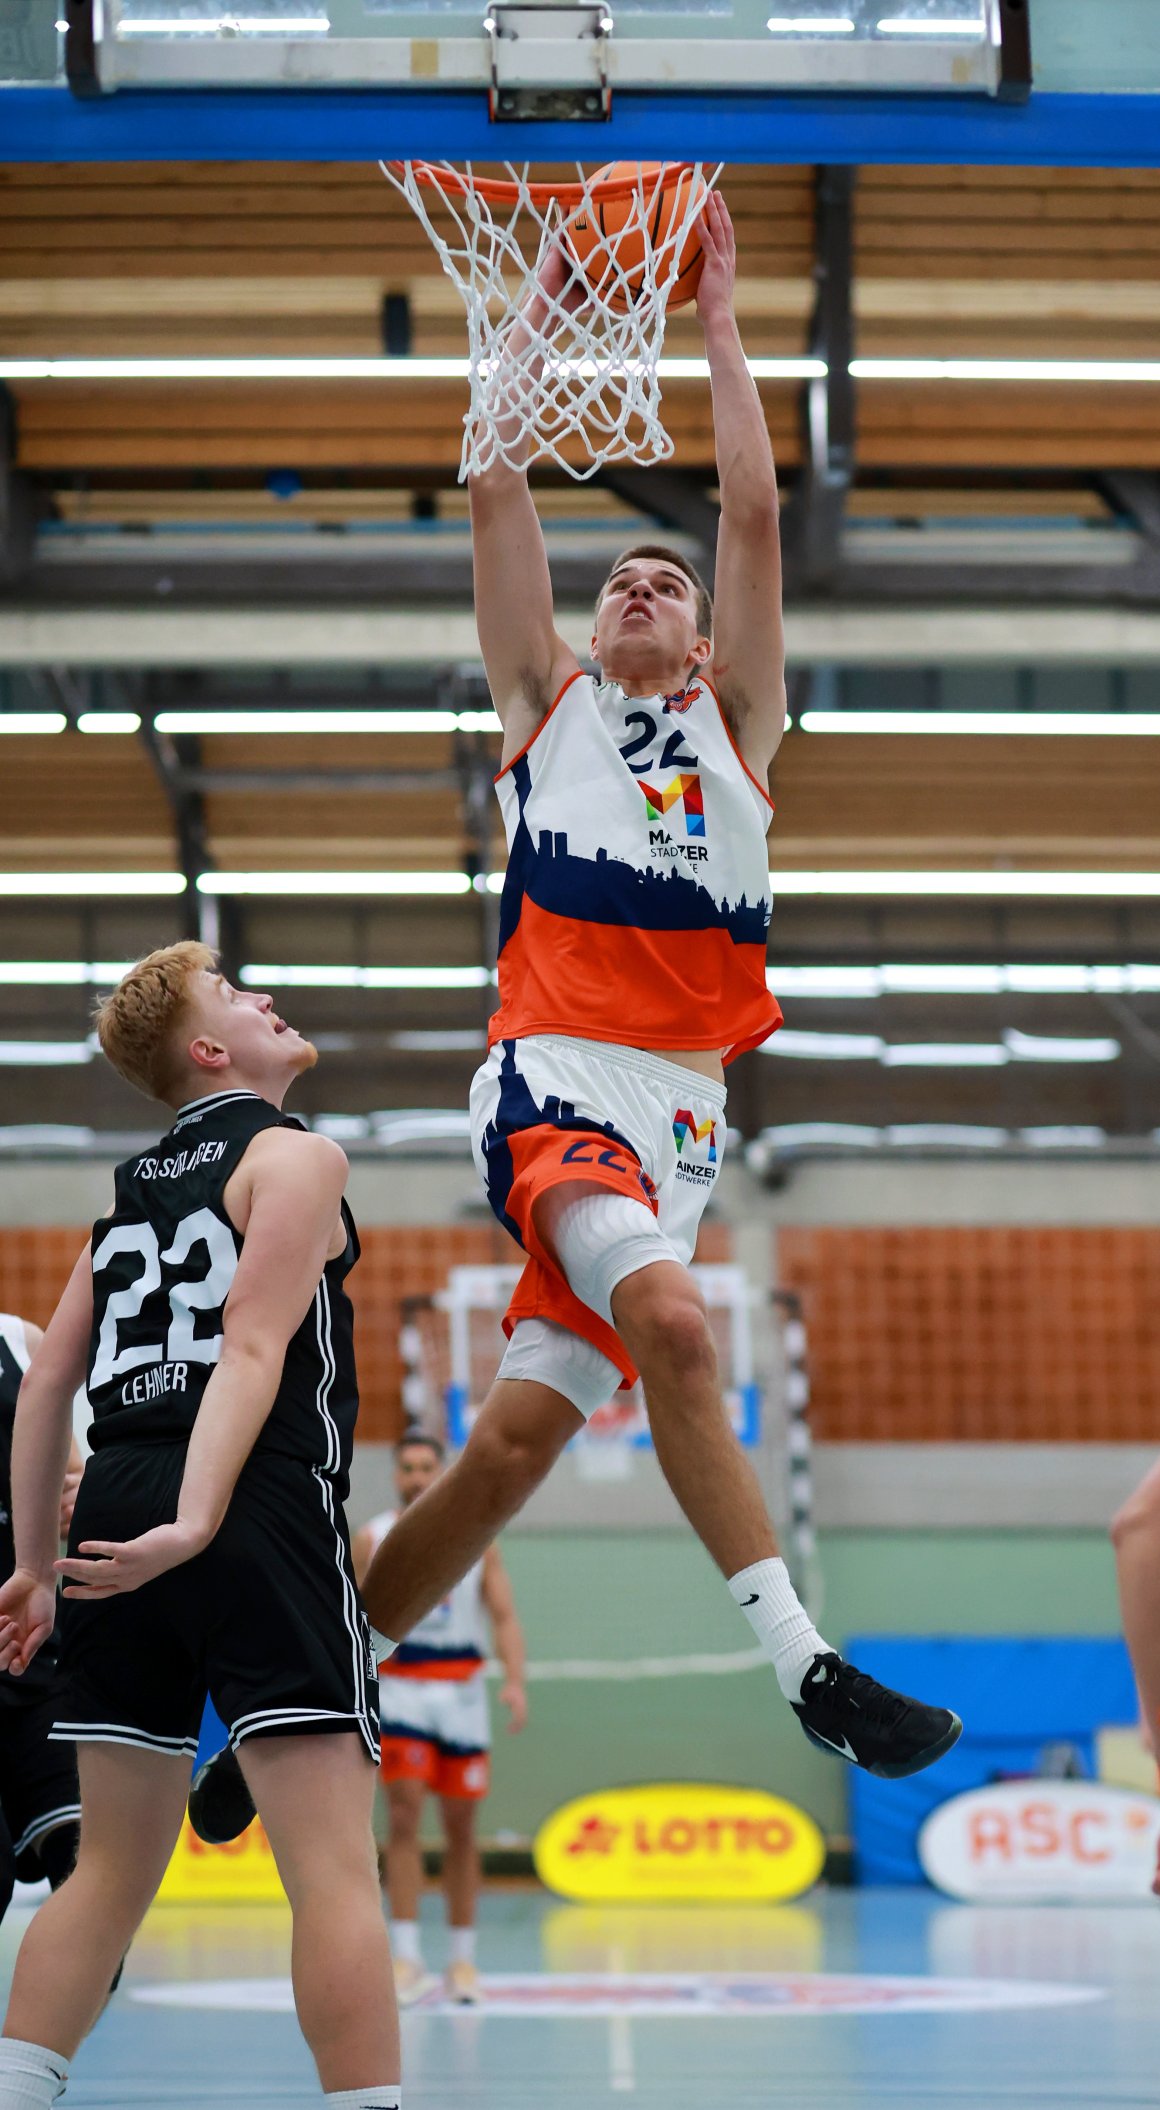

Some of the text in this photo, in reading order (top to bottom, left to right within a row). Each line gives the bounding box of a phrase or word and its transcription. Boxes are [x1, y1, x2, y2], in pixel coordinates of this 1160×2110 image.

[619, 711, 698, 774] 22
[649, 829, 709, 861] MAZER
[676, 1160, 716, 1179] AINZE
[88, 1207, 239, 1392] 22
[121, 1362, 188, 1406] LEHNER
[633, 1817, 795, 1856] LOTTO
[968, 1802, 1112, 1864] ASC
